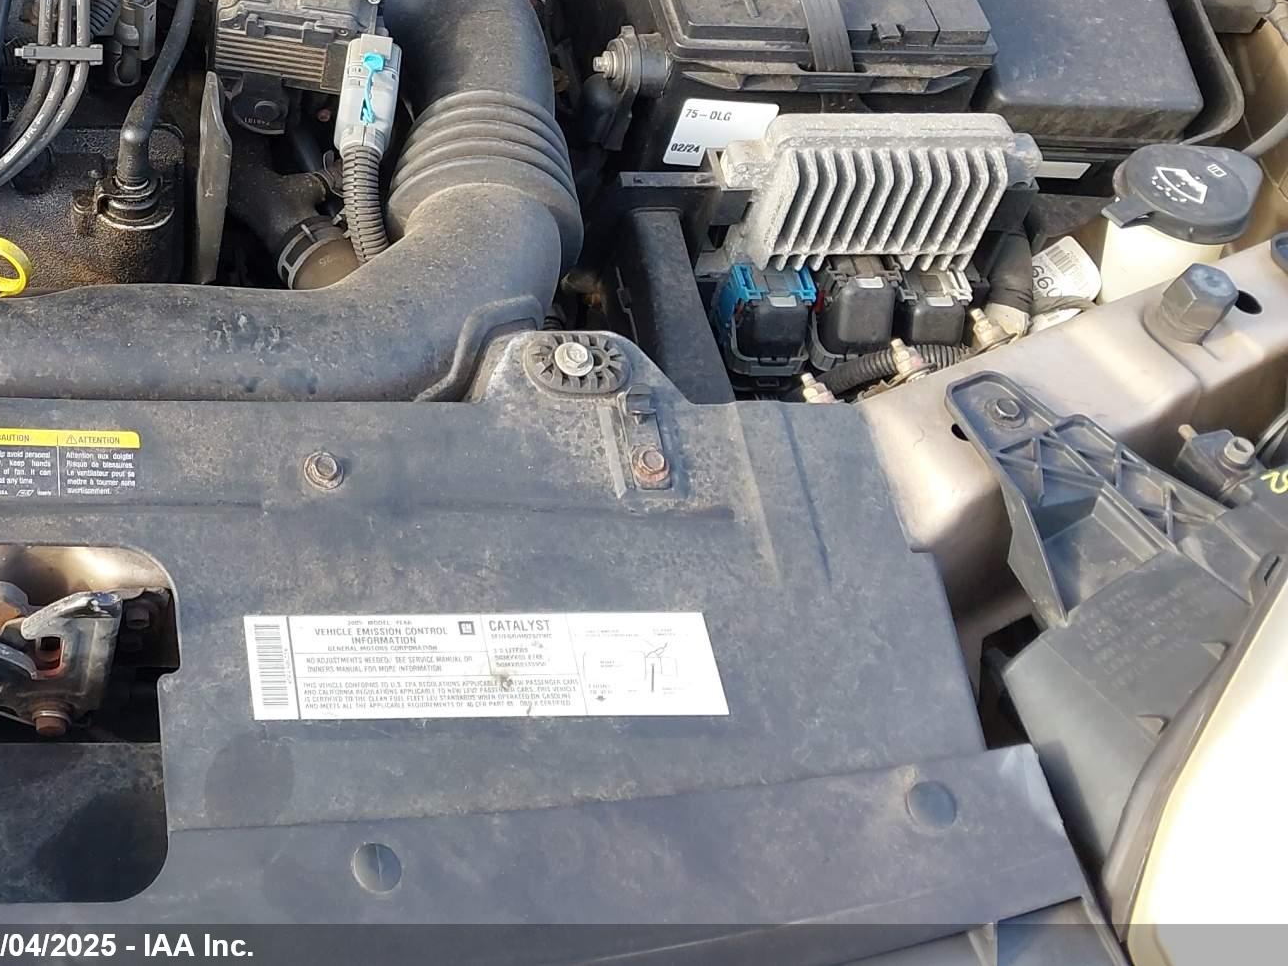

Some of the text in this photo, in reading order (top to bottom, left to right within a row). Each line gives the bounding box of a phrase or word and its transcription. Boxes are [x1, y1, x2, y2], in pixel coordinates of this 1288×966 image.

[670, 142, 701, 154] 02/24
[79, 436, 120, 444] ATTENTION
[488, 619, 550, 631] CATALYST
[314, 627, 448, 636] VEHICLE EMISSION CONTROL
[351, 636, 417, 645] INFORMATION
